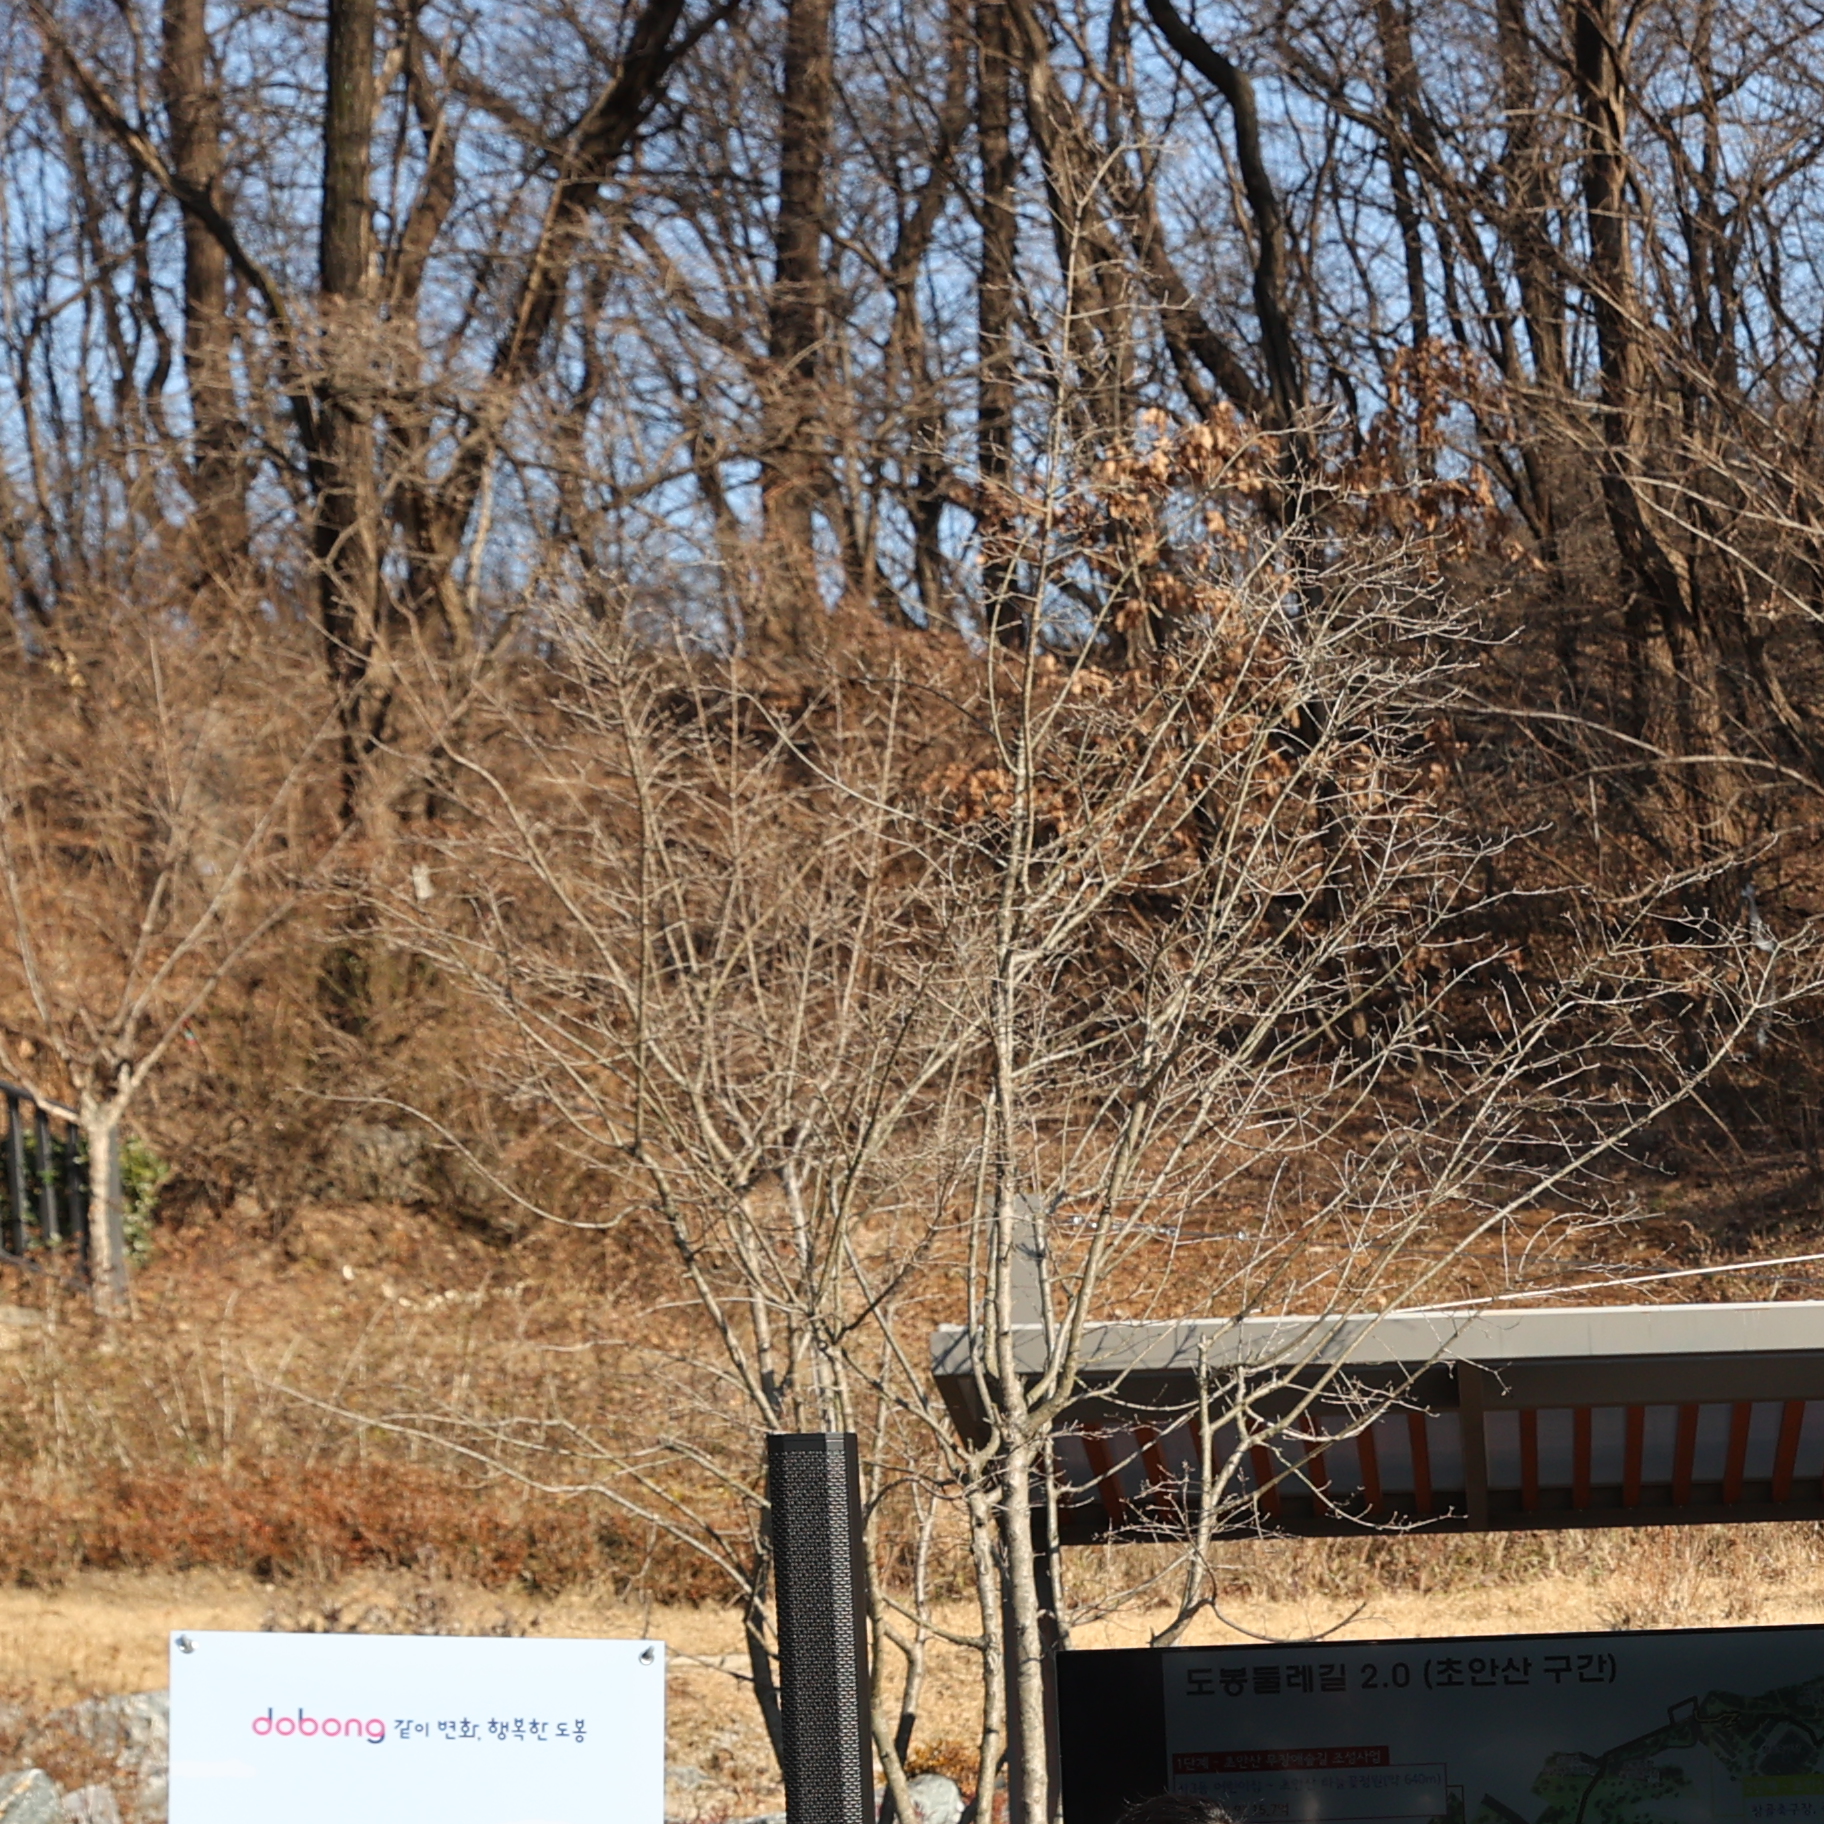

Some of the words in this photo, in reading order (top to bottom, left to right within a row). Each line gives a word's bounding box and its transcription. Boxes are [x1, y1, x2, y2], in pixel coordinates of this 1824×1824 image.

[1186, 1661, 1347, 1697] 도봉둘레길
[1360, 1663, 1411, 1690] 2.0
[1423, 1656, 1532, 1690] (초안산
[1543, 1652, 1617, 1685] 구간)
[252, 1708, 385, 1744] dobong
[395, 1719, 429, 1740] 같이
[438, 1717, 481, 1741] 변화,
[487, 1717, 549, 1742] 행복한
[555, 1718, 587, 1744] 도봉
